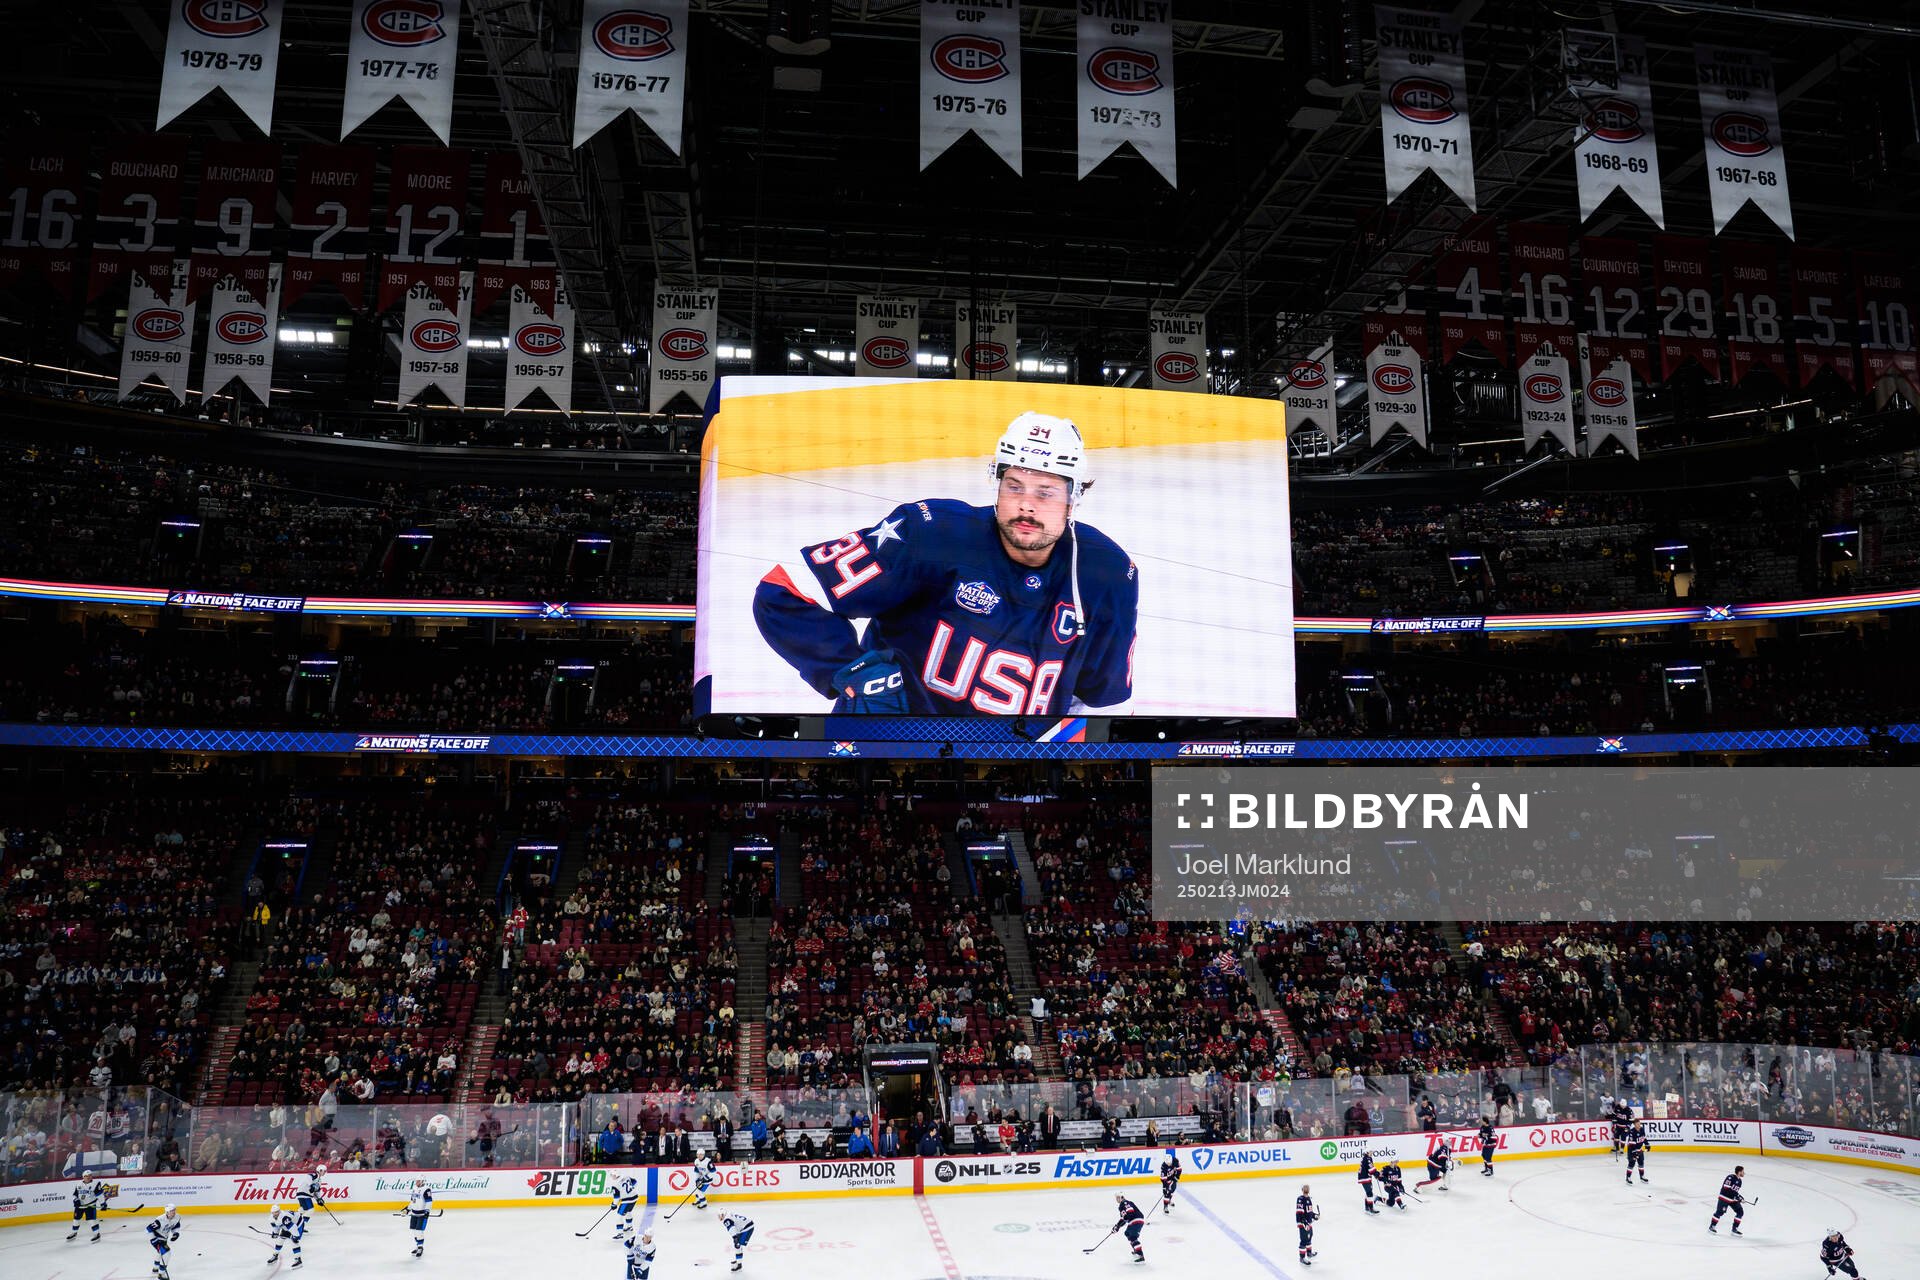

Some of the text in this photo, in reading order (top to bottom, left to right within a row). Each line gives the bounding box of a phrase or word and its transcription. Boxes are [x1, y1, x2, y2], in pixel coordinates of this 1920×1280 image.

[956, 10, 985, 23] CUP
[1111, 23, 1140, 36] CUP
[1380, 26, 1459, 53] STANLEY
[180, 49, 262, 71] 1978-79
[1409, 53, 1434, 66] CUP
[360, 59, 439, 80] 1977-78
[1700, 63, 1770, 88] STANLEY
[591, 72, 670, 93] 1976-77
[1726, 88, 1749, 101] CUP
[932, 94, 1007, 115] 1975-76
[1393, 133, 1458, 155] 1970-71
[30, 156, 64, 173] LACH
[111, 161, 178, 179] BOUCHARD
[1584, 153, 1648, 174] 1968-69
[311, 171, 359, 187] HARVEY
[407, 174, 453, 190] MOORE
[1716, 167, 1777, 186] 1967-68
[1, 187, 78, 249] 16
[119, 193, 157, 252] 3
[216, 198, 254, 256] 9
[311, 201, 348, 260] 2
[389, 203, 460, 265] 12
[505, 209, 531, 268] 1
[99, 262, 118, 273] 1941
[149, 265, 169, 276] 1956
[197, 266, 218, 278] 1942
[1583, 258, 1639, 273] COURNOYER
[245, 268, 265, 279] 1960
[292, 270, 312, 281] 1947
[341, 272, 361, 283] 1961
[388, 273, 408, 285] 1951
[1733, 267, 1767, 281] SAVARD
[434, 276, 455, 287] 1963
[483, 277, 503, 288] 1952
[531, 279, 550, 290] 1963
[1456, 266, 1489, 320] 4
[1519, 272, 1571, 326] 16
[657, 294, 716, 310] STANLEY
[676, 311, 696, 320] CUP
[859, 303, 917, 319] STANLEY
[1588, 285, 1643, 338] 12
[1660, 286, 1715, 338] 29
[1732, 292, 1782, 344] 18
[878, 320, 898, 329] CUP
[1150, 318, 1203, 336] STANLEY
[1808, 297, 1836, 347] 5
[1866, 301, 1911, 351] 10
[1168, 335, 1186, 345] CUP
[1520, 333, 1538, 344] 1955
[130, 350, 181, 363] 1959-60
[214, 354, 264, 366] 1958-59
[1534, 358, 1551, 367] CUP
[409, 361, 459, 374] 1957-58
[515, 364, 564, 376] 1956-57
[658, 369, 708, 382] 1955-56
[1287, 397, 1328, 409] 1930-31
[1375, 402, 1416, 414] 1929-30
[1527, 410, 1566, 423] 1923-24
[1591, 414, 1628, 426] 1915-16
[1029, 425, 1051, 439] 34
[1020, 446, 1052, 457] CCM
[809, 531, 883, 600] 34
[185, 594, 242, 606] NATIONS
[958, 582, 1000, 604] NATIONS
[1058, 610, 1076, 635] C
[1384, 620, 1432, 630] NATIONS
[923, 620, 1064, 715] USA
[371, 738, 428, 748] NATIONS
[1192, 744, 1242, 754] NATIONS
[1641, 1122, 1683, 1133] TRULY
[1693, 1122, 1739, 1134] TRULY
[1340, 1140, 1368, 1148] INTUIT
[1218, 1149, 1291, 1165] FANDUEL
[800, 1162, 896, 1179] BODYARMOR
[959, 1162, 1041, 1177] NHL 25
[1054, 1155, 1154, 1178] FASTENAL
[535, 1169, 607, 1195] BET99
[711, 1169, 780, 1188] OGERS
[847, 1178, 872, 1187] Sports
[233, 1176, 350, 1200] Tim Hoons
